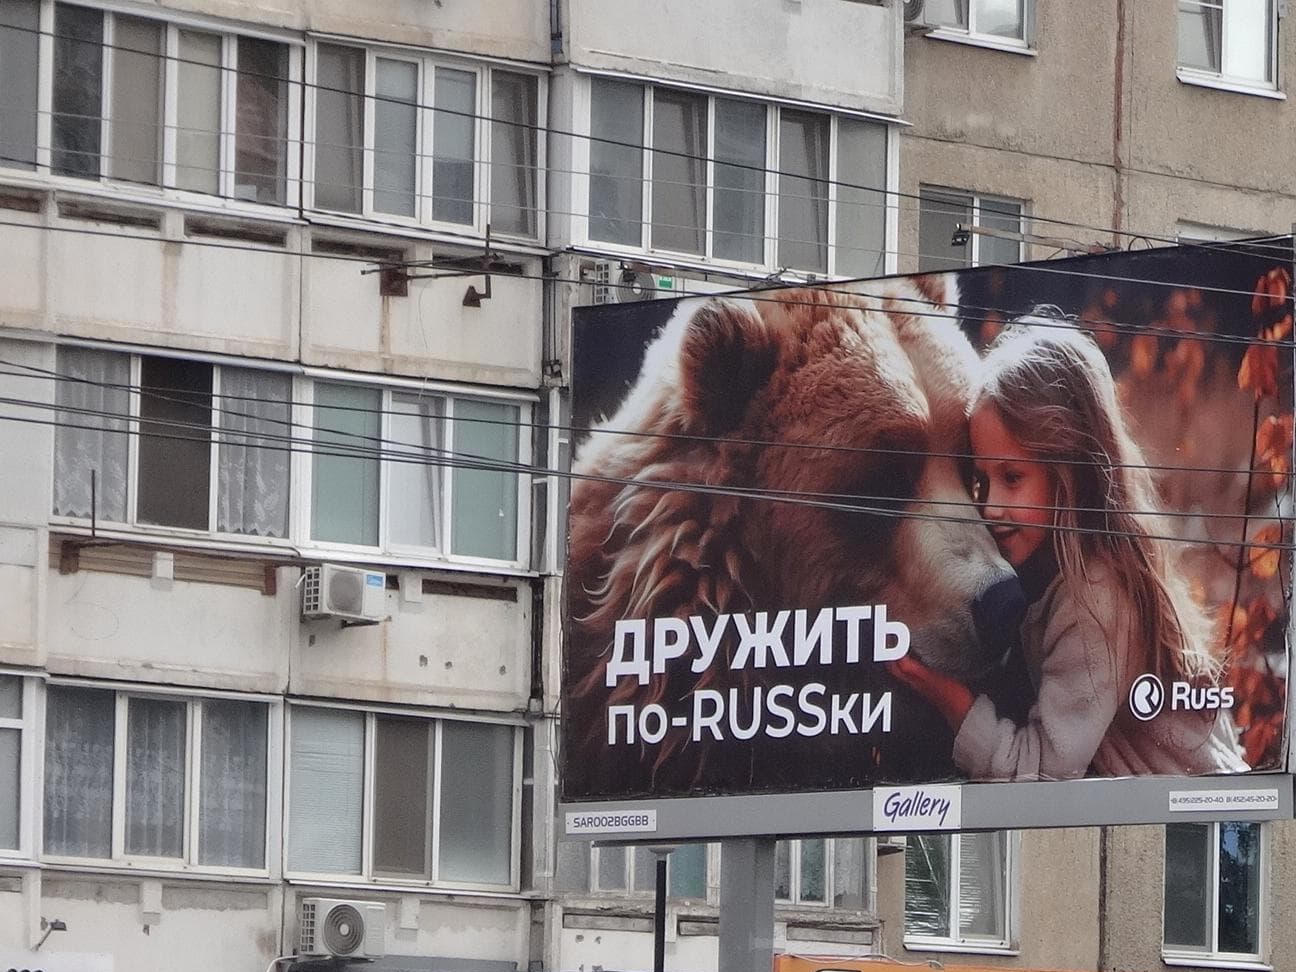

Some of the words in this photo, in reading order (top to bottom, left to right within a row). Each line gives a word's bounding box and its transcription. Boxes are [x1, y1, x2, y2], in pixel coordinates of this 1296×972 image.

[606, 604, 911, 687] ДРУЖИТЬ
[607, 683, 893, 745] по-RUSSки
[1171, 681, 1235, 711] Russ
[883, 791, 952, 826] Gallery
